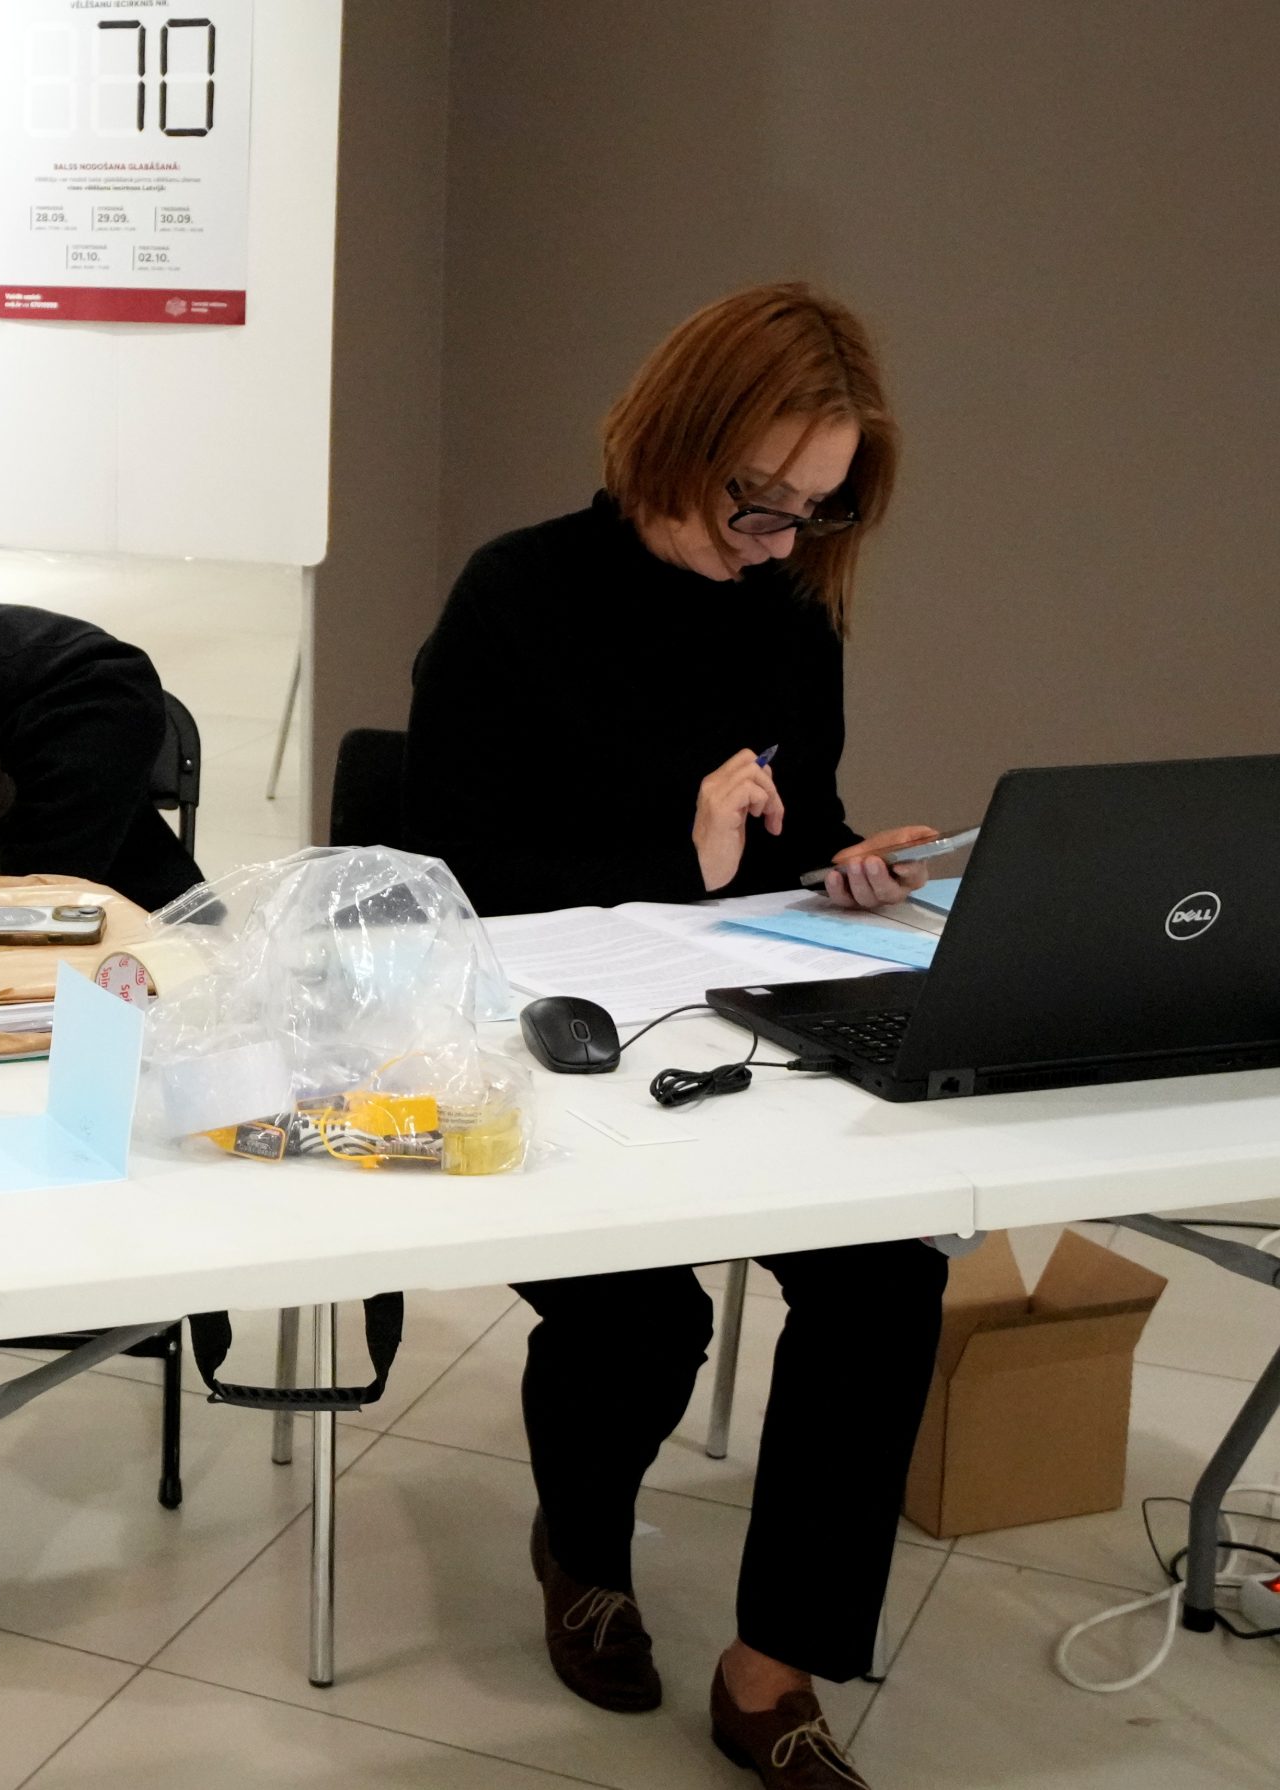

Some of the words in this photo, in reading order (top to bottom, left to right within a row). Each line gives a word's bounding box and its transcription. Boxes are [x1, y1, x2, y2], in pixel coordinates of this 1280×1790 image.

[97, 18, 216, 137] 70
[53, 163, 78, 171] BALSS
[79, 162, 126, 171] NODOŠANA
[35, 212, 67, 223] 28.09.
[97, 213, 129, 223] 29.09.
[160, 213, 193, 224] 30.09.
[71, 251, 100, 262] 01.10.
[138, 252, 170, 263] 02.10.
[1172, 909, 1212, 923] DELL
[99, 966, 112, 989] Spin
